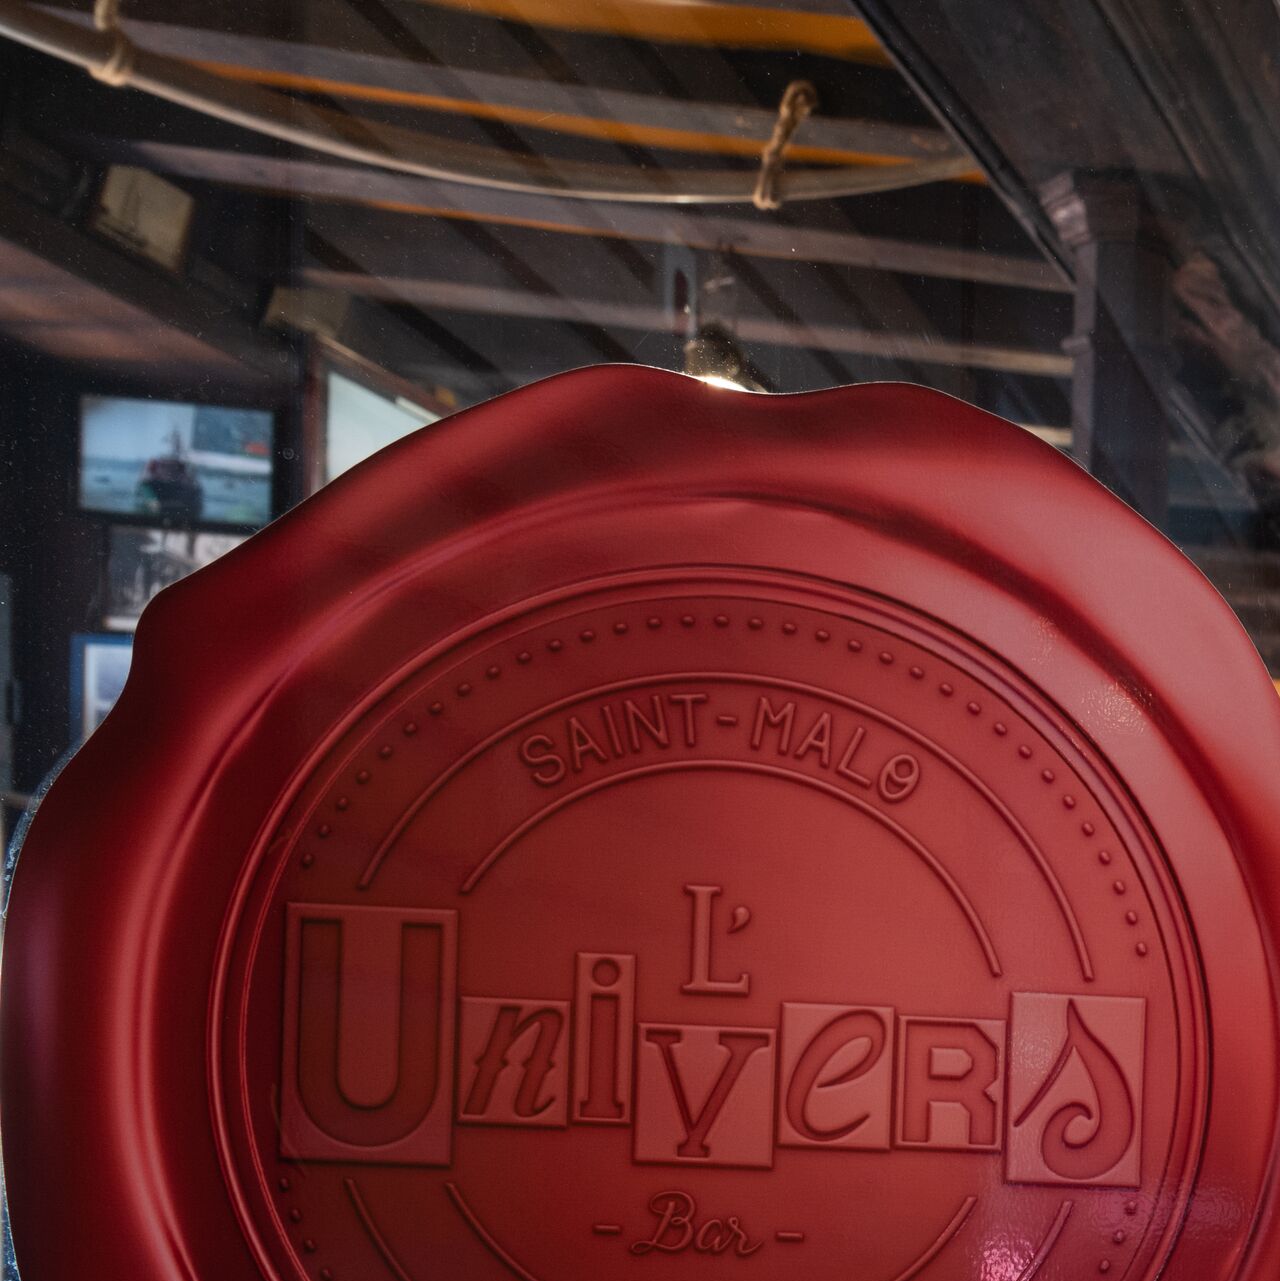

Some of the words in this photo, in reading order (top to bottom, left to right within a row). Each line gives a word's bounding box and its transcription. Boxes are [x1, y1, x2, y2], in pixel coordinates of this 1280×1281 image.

[521, 694, 920, 801] SAINT-MALO
[681, 885, 752, 995] L'
[630, 1191, 764, 1256] Bar
